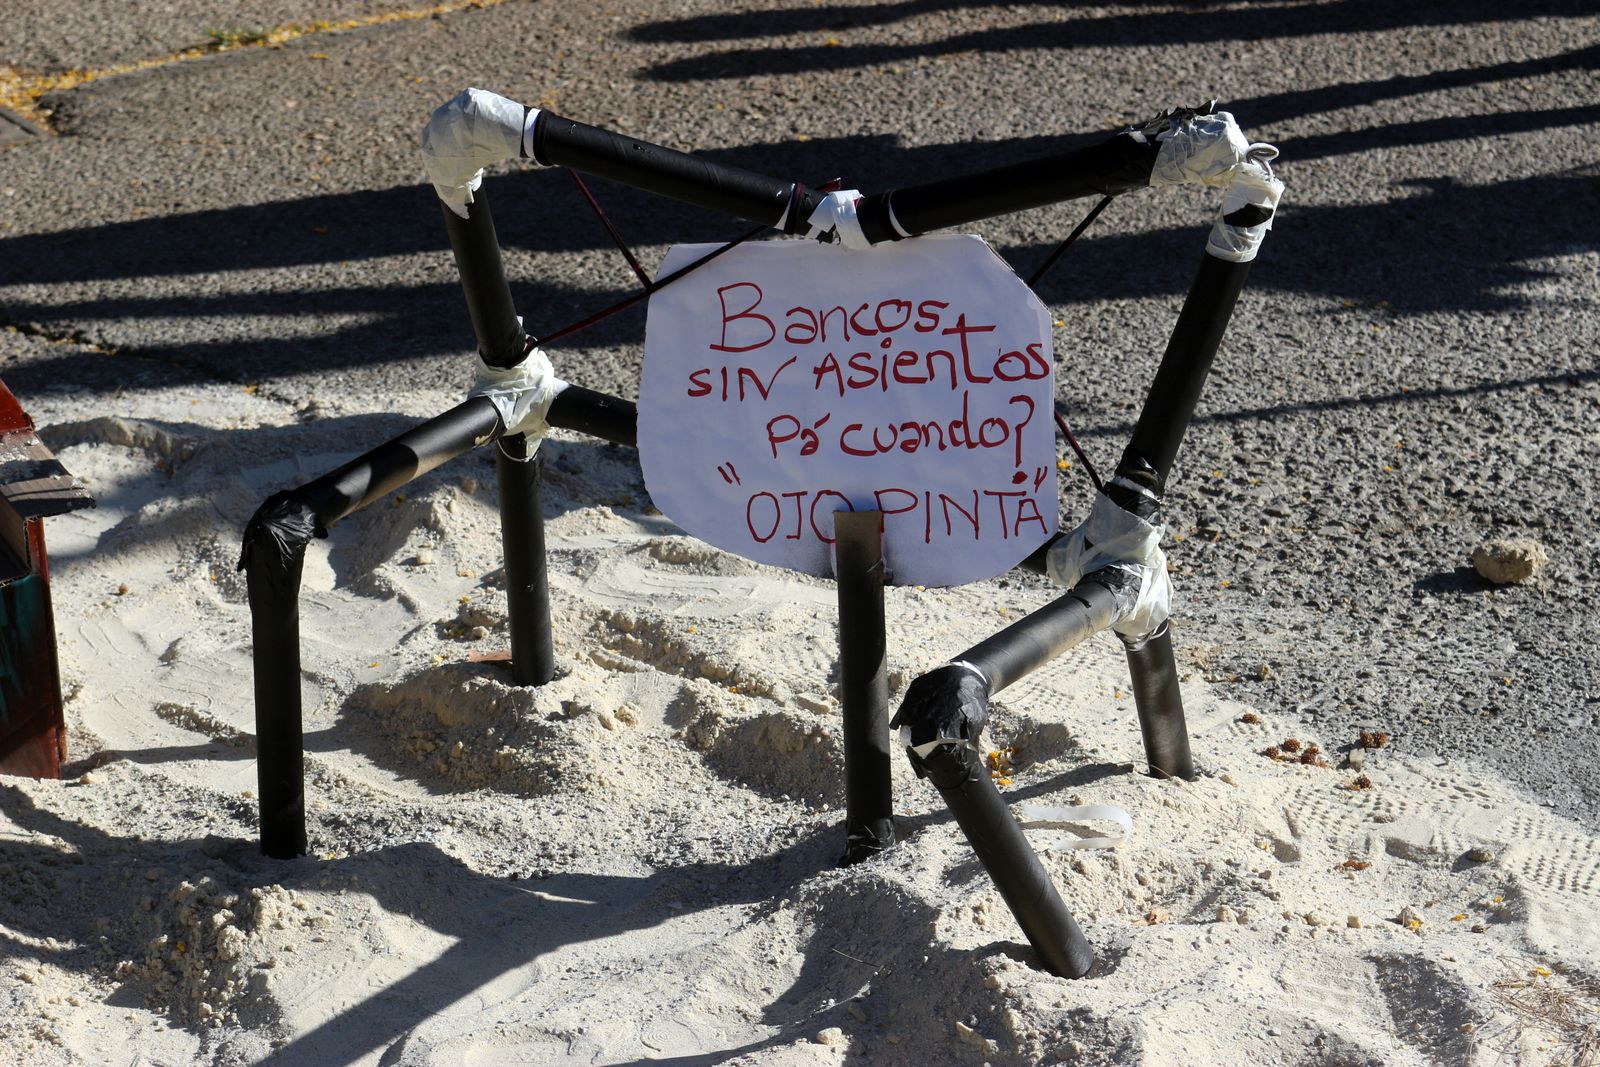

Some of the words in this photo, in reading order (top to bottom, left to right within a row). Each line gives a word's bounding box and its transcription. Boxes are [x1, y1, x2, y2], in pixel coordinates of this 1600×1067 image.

[709, 282, 950, 352] Bancos
[687, 356, 797, 401] SIN
[840, 390, 1035, 485] cuando?
